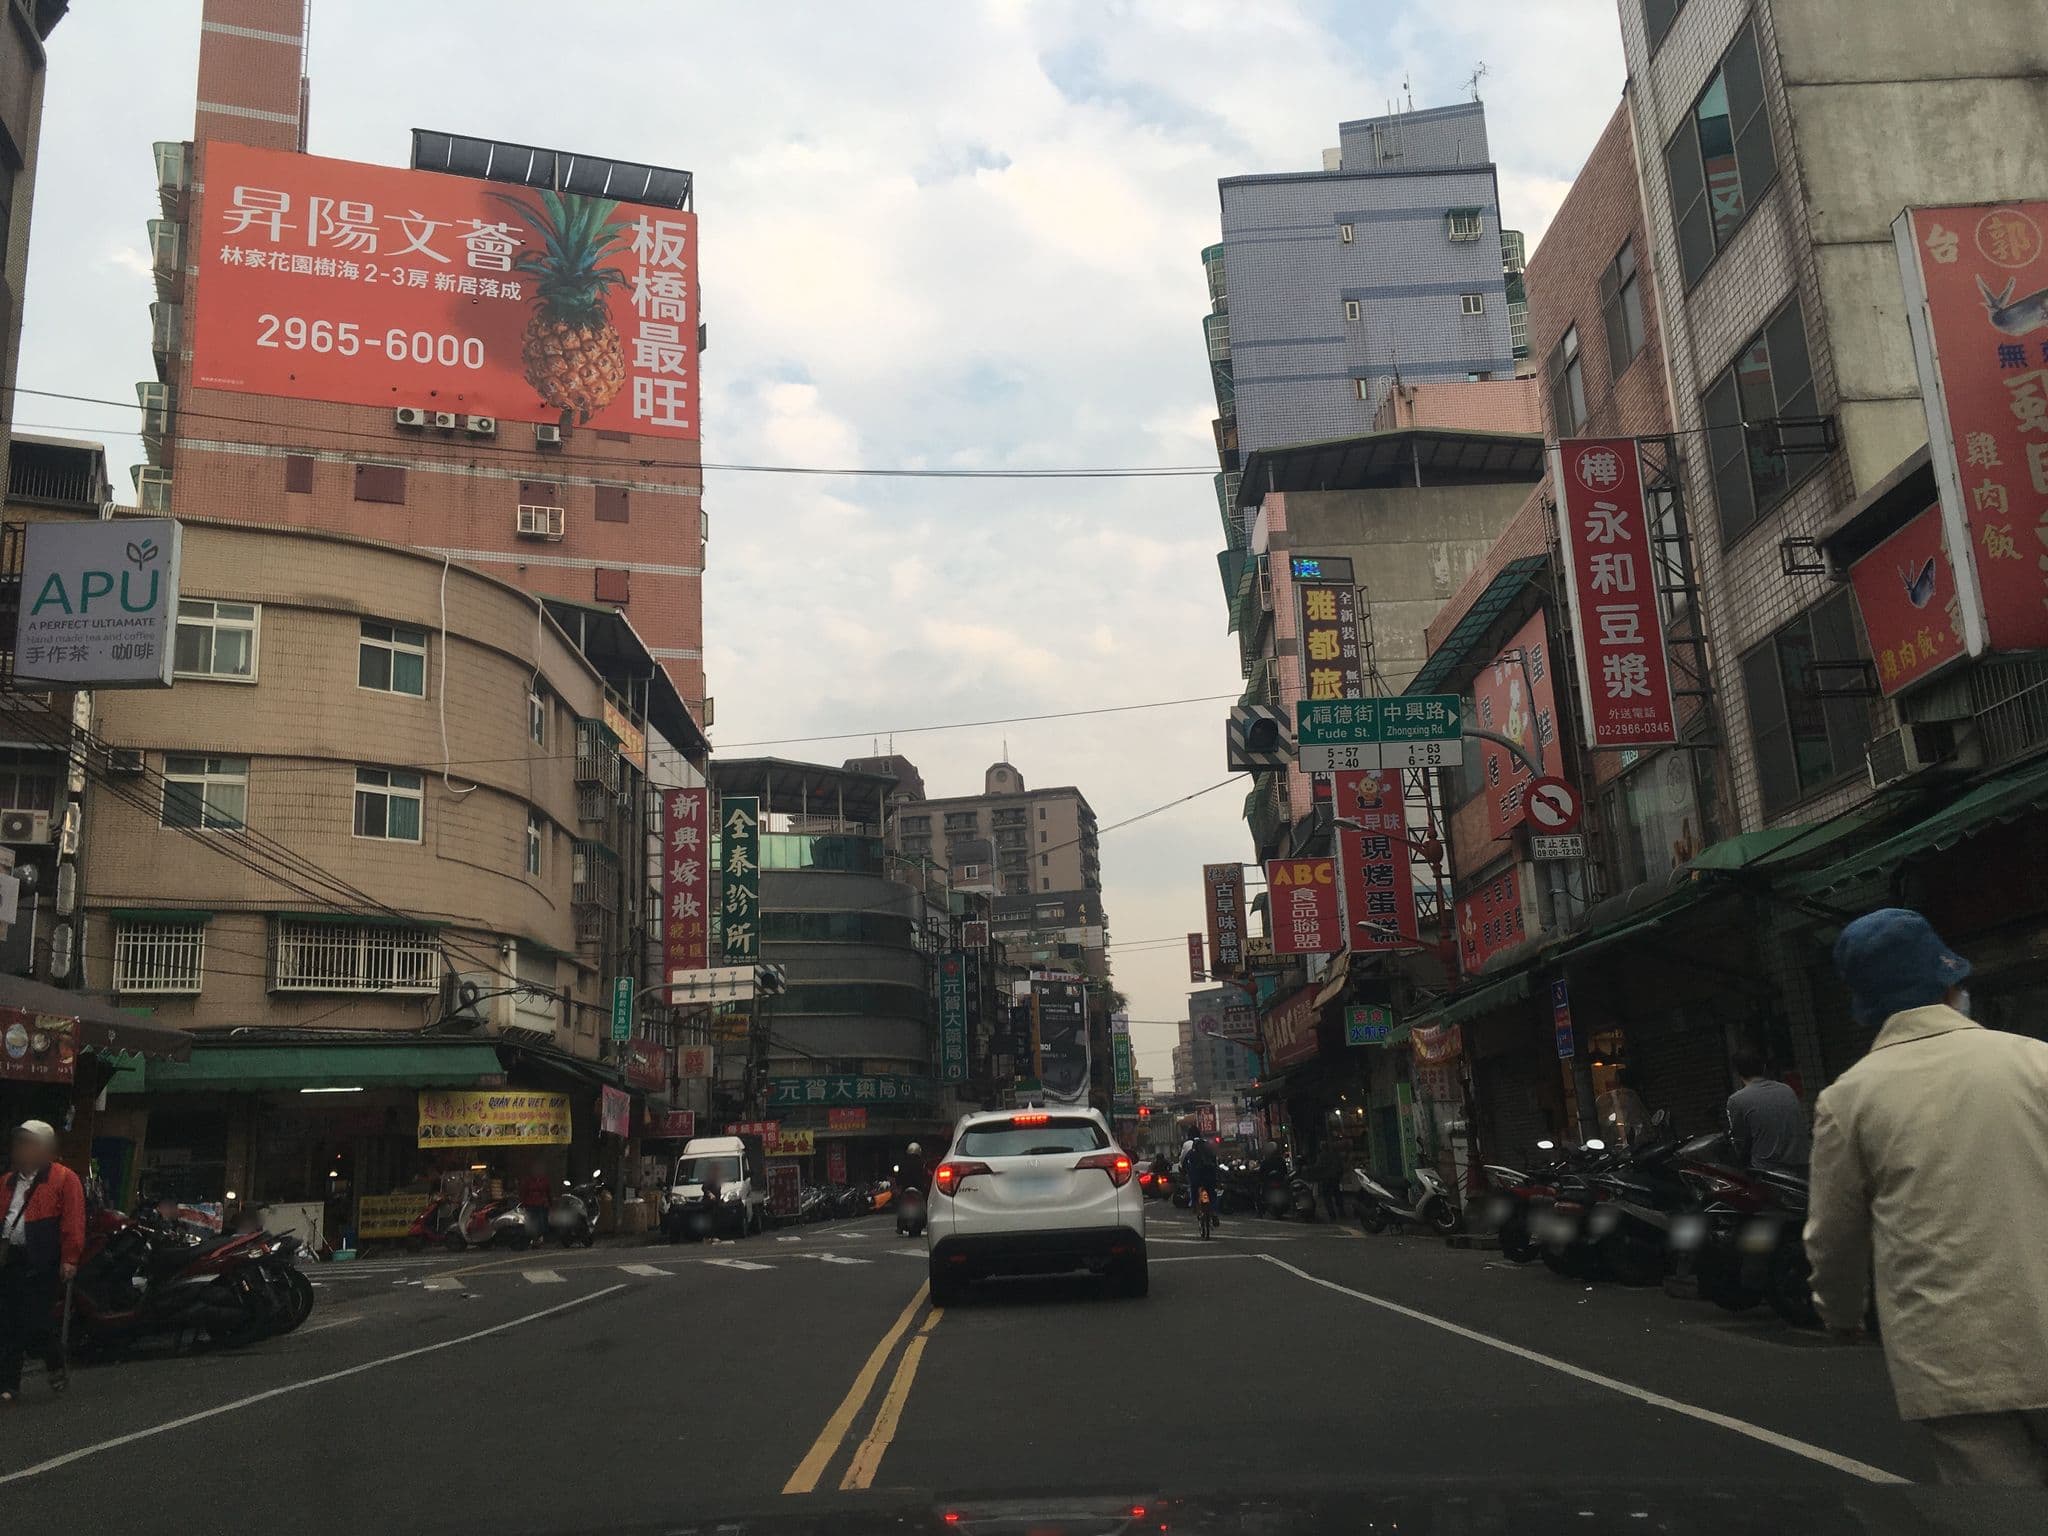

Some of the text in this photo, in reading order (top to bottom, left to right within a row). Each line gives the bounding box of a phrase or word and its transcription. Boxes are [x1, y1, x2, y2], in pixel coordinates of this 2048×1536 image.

[222, 184, 525, 273] 昇陽文薈
[1925, 223, 1959, 264] 台
[1987, 216, 2031, 261] 郭
[220, 244, 360, 281] 林家花園樹海
[434, 270, 522, 301] 新居落成
[256, 313, 486, 370] 2965-6000
[631, 214, 689, 429] 板橋最旺
[1581, 452, 1618, 487] 樺
[1965, 431, 2024, 561] 雞肉飯
[30, 569, 160, 616] APU
[1585, 501, 1652, 699] 永和豆漿
[29, 617, 156, 630] A PERFECT ULTIAMATE
[1339, 591, 1357, 659] 全新裝潢
[26, 642, 154, 664] 手作茶 咖啡
[1312, 701, 1446, 724] 福德街 中興路
[1317, 724, 1444, 739] Fude St. Zhongxing Rd.
[1608, 706, 1657, 721] 外送電話
[670, 793, 701, 920] 新興嫁妝
[1537, 838, 1580, 849] 禁止左轉
[725, 808, 758, 954] 全泰診所
[1273, 862, 1333, 886] ABC
[1361, 837, 1402, 944] 現烤蛋糕
[1215, 883, 1240, 963] 古早味蛋糕
[1289, 887, 1322, 949] 食品聯盟
[944, 978, 961, 1060] 元賀大藥局
[779, 1078, 897, 1101] 元賀大藥局
